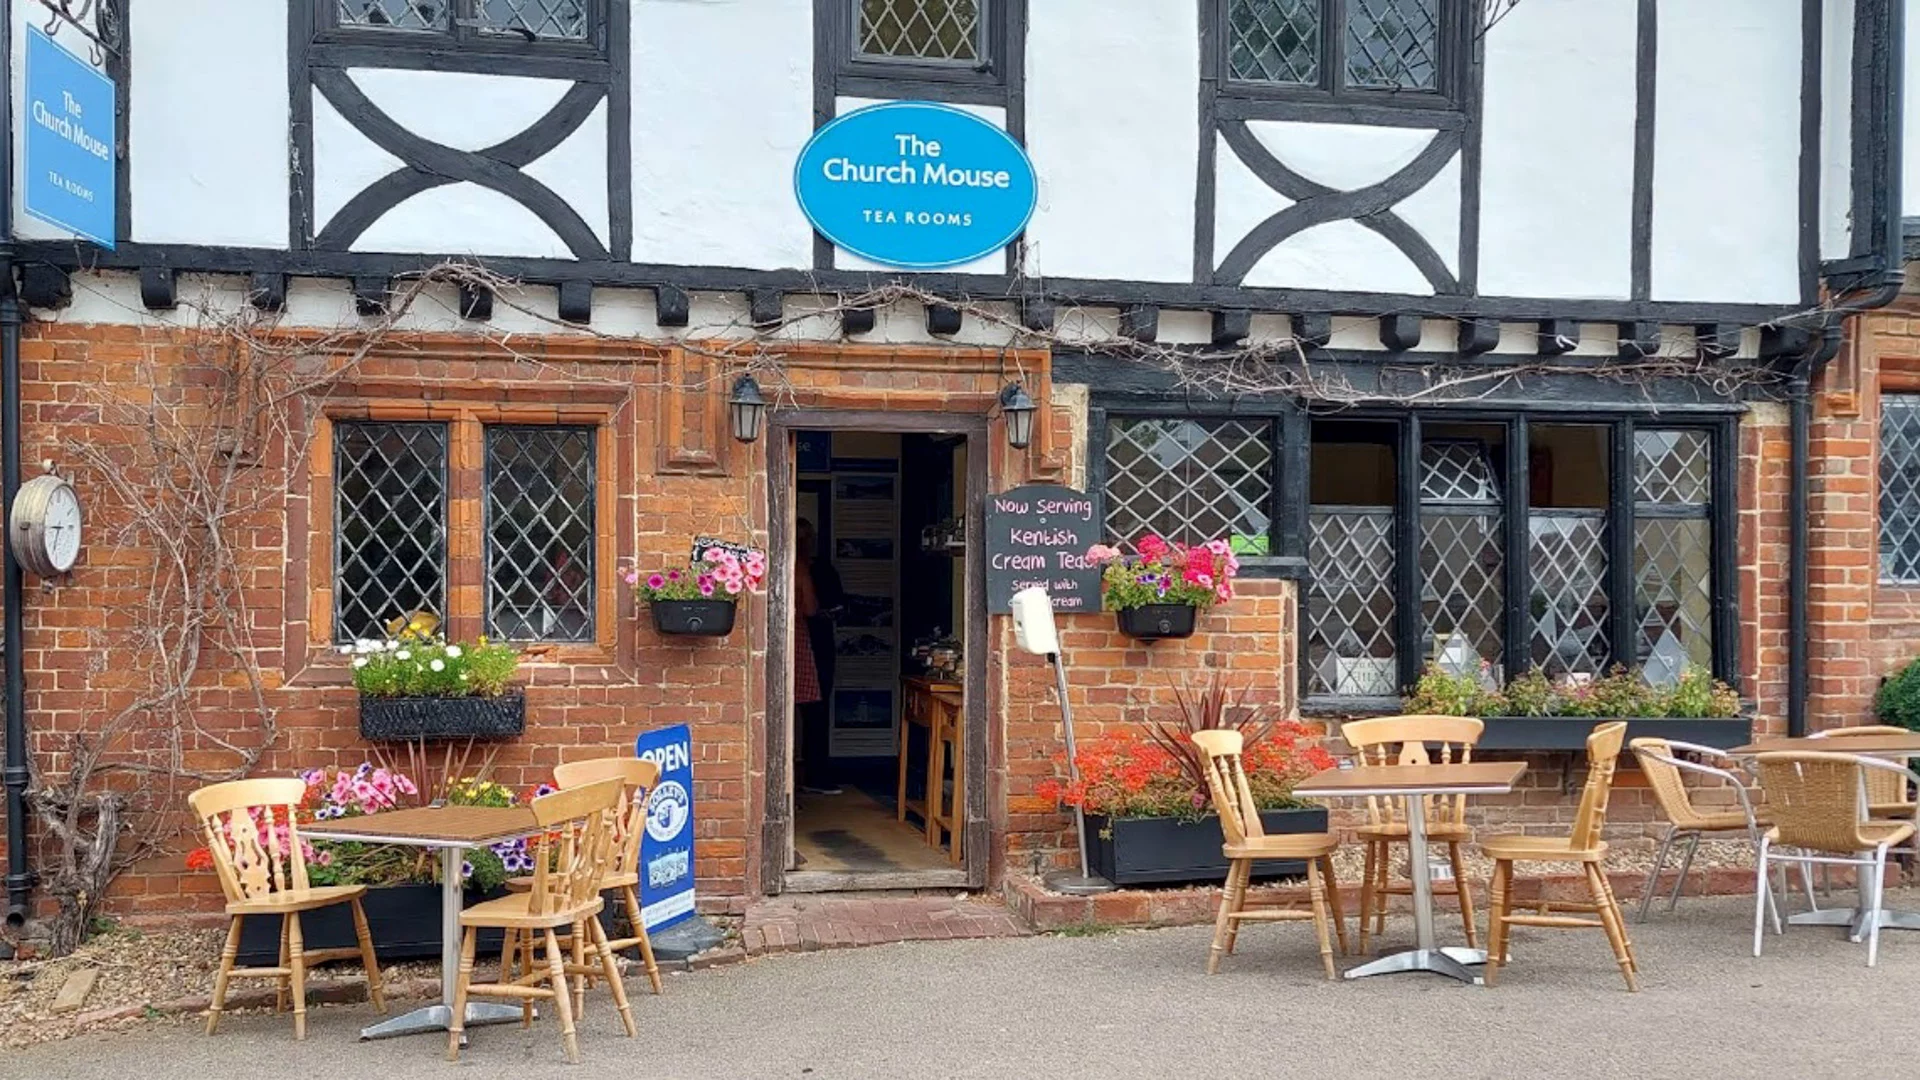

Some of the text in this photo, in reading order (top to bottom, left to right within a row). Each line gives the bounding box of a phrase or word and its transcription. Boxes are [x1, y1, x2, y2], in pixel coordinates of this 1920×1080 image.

[62, 90, 82, 119] The
[33, 100, 108, 160] Church Mouse
[895, 134, 941, 157] The
[823, 158, 1010, 188] Church Mouse
[49, 171, 94, 202] TEA ROOMS
[863, 210, 972, 226] TEA ROOMS
[994, 498, 1092, 521] Now Serving
[1010, 527, 1078, 546] Kentish
[992, 553, 1045, 570] Cream
[1054, 578, 1078, 590] with
[1052, 596, 1083, 607] cream
